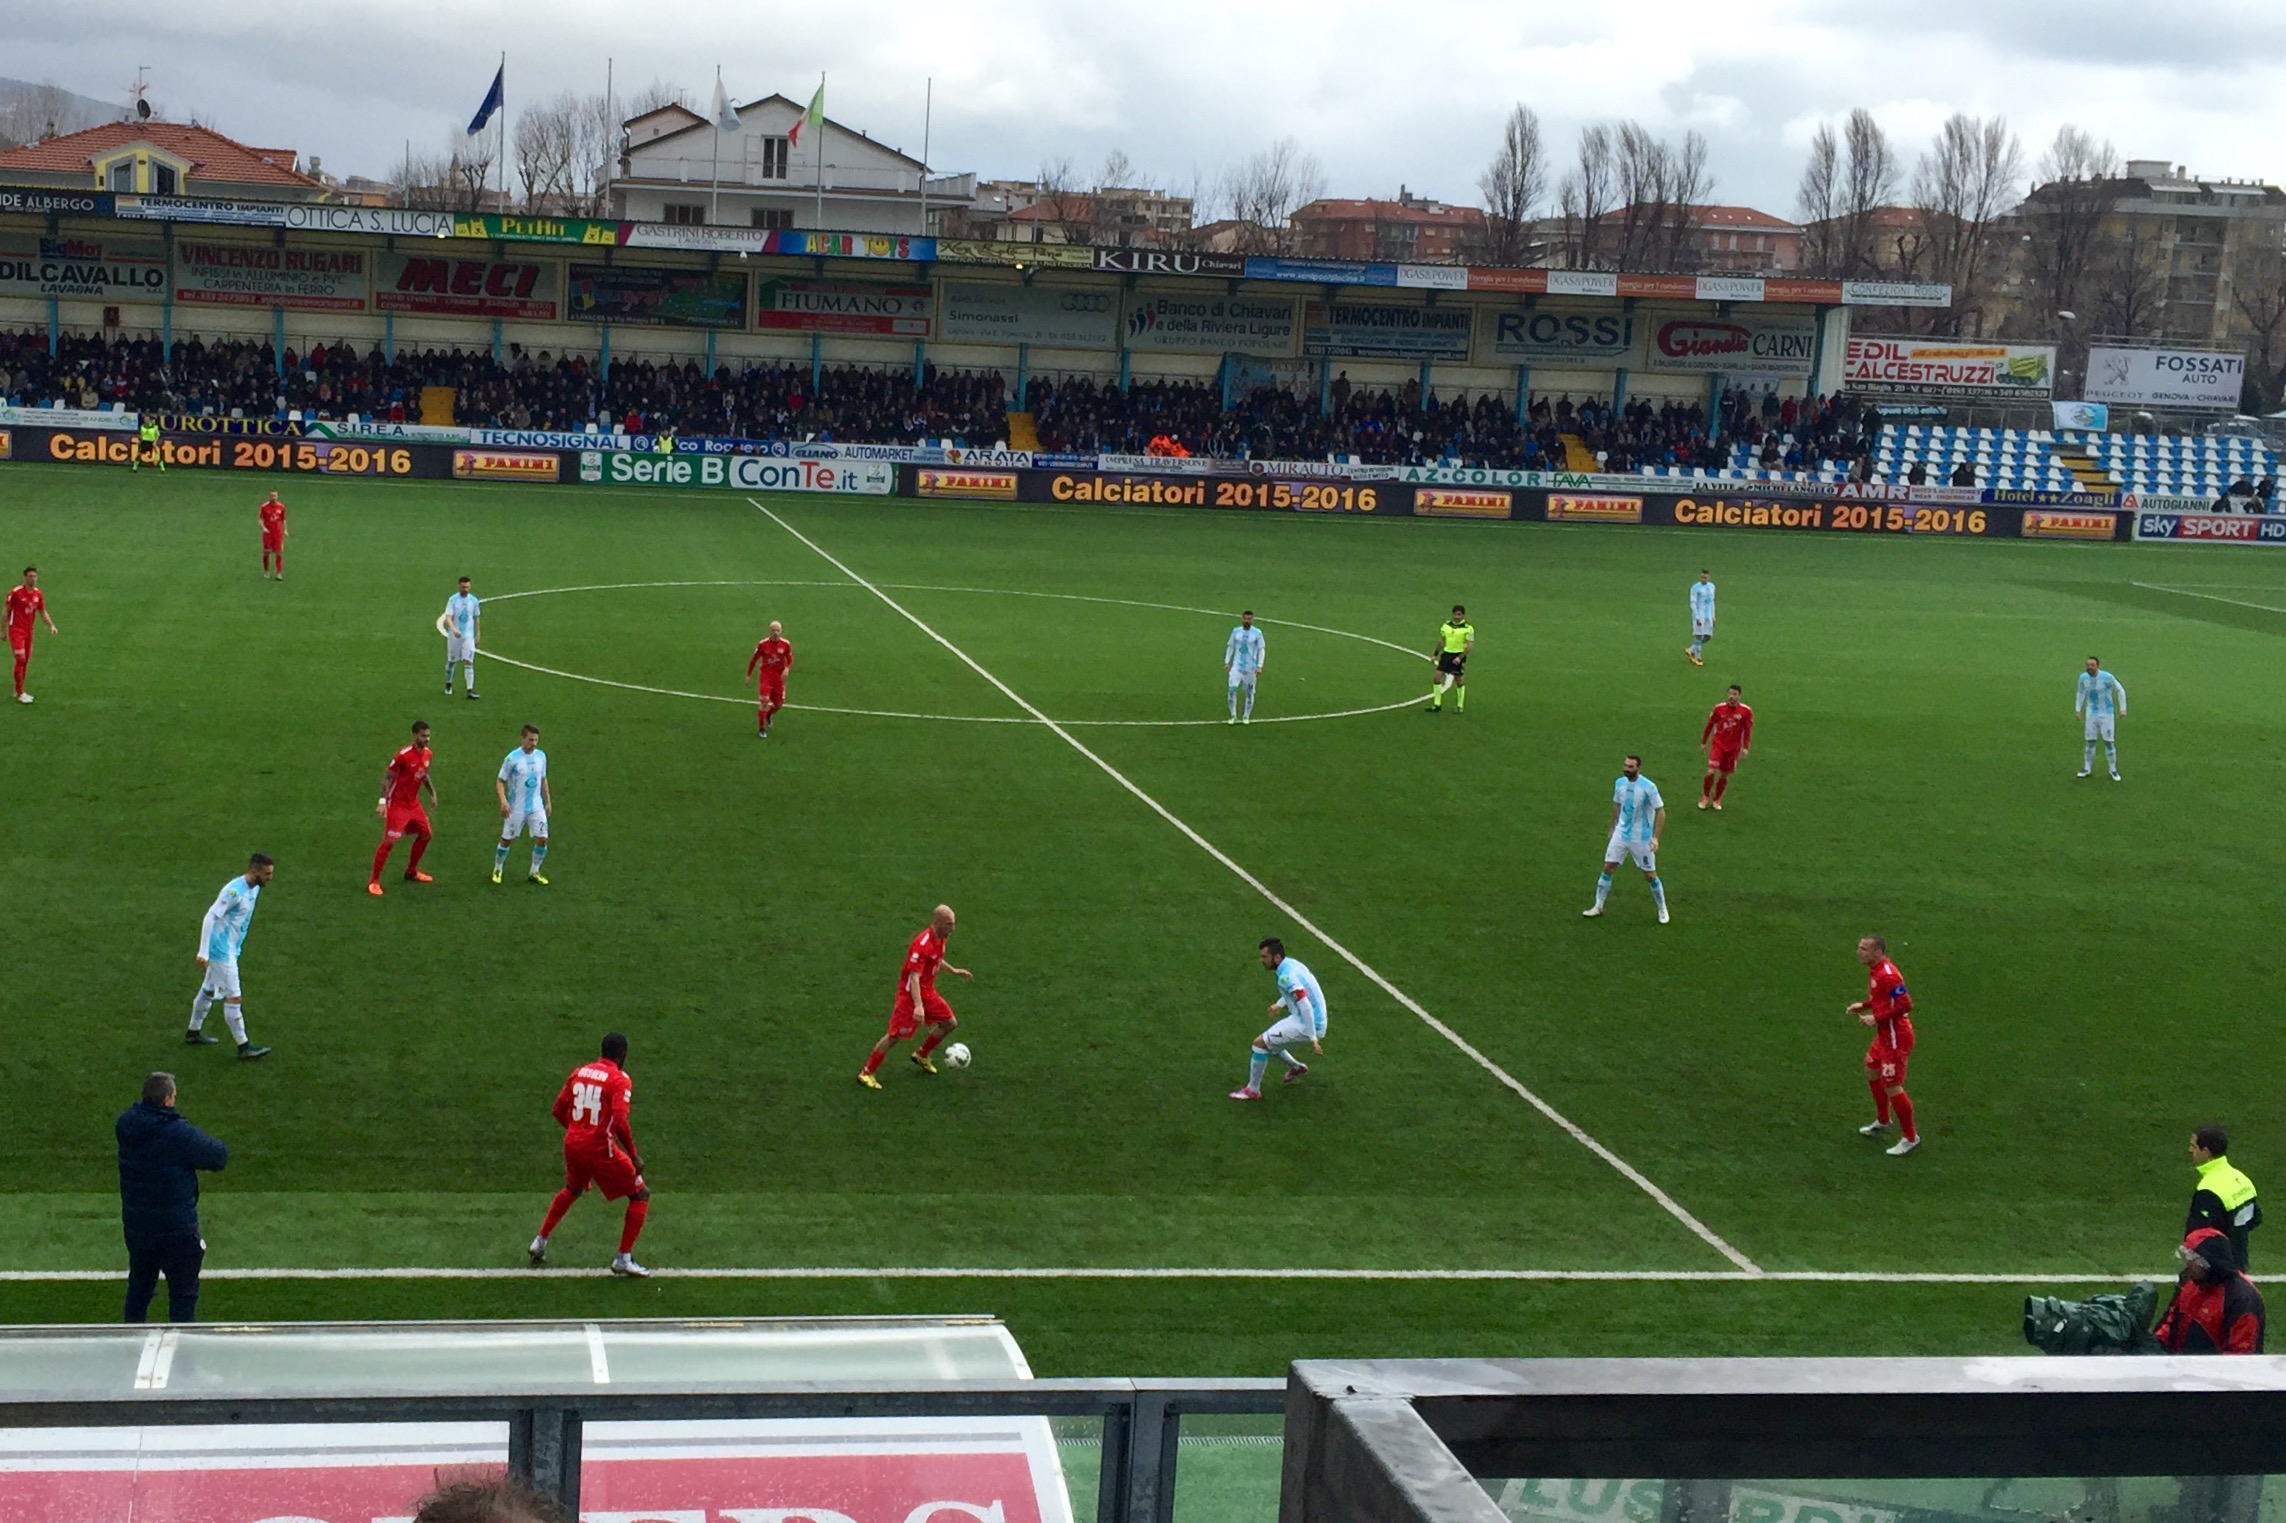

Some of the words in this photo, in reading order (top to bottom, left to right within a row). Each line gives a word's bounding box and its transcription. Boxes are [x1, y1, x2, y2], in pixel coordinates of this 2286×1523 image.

[0, 194, 21, 206] DE
[26, 196, 94, 211] ALBERGO
[139, 198, 234, 211] TERMOCENTRO
[237, 204, 284, 214] IMPIANTI
[288, 206, 363, 230] OTTICA
[370, 211, 385, 231] S.
[391, 212, 451, 235] LUCIA
[636, 225, 700, 239] GASTRINI
[701, 228, 763, 241] ROBERTO
[805, 233, 853, 256] ACAR
[178, 241, 281, 270] VINCENZO
[284, 250, 363, 274] RUGARI
[1202, 259, 1242, 271] Chiavari
[191, 267, 230, 279] INFISSI
[245, 271, 309, 282] ALLUMINIO
[323, 274, 348, 285] PVC
[396, 258, 541, 299] MECI
[40, 283, 104, 296] LAVAGNA
[203, 279, 282, 294] CARPENTERIA
[285, 285, 295, 294] in
[297, 284, 336, 296] FERRO
[781, 292, 902, 314] FIUMANO
[1157, 299, 1206, 317] Banco
[1211, 301, 1224, 317] di
[1229, 302, 1292, 321] Chiavari
[948, 310, 1019, 324] Simonassi
[1328, 305, 1420, 328] TERMOCENTRO
[1422, 310, 1471, 329] IMPIANTI
[1156, 321, 1164, 331] e
[1167, 319, 1198, 333] della
[1201, 321, 1246, 335] Riviera
[1250, 324, 1291, 339] Ligure
[1497, 313, 1633, 346] ROSSI
[1154, 336, 1197, 346] GRUPPO
[1201, 338, 1236, 347] BANCO
[1238, 339, 1288, 349] POPOLARE
[1752, 333, 1814, 358] CARNI
[1848, 341, 1908, 361] EDIL
[2155, 356, 2242, 374] FOSSATI
[2182, 374, 2217, 385] AUTO
[2086, 390, 2144, 400] PEUGEOT
[2151, 392, 2190, 401] GENOVA
[152, 415, 302, 436] UROTTICA
[480, 431, 624, 450] TECNOSIGNAL
[234, 441, 412, 475] 2015-2016
[484, 456, 554, 470] PANINI
[844, 446, 914, 462] AUTOMARKET
[963, 450, 1030, 463] ARATA
[611, 453, 692, 484] Serie
[702, 457, 724, 484] B
[738, 459, 858, 491] ConTe.it
[945, 475, 1012, 488] PANINI
[1553, 471, 1592, 489] FAVA
[1052, 475, 1204, 505] Calciatori
[1215, 482, 1377, 512] 2015-2016
[1442, 494, 1506, 508] PANINI
[1840, 484, 1911, 500] AMR
[1993, 489, 2035, 502] Hotel
[2060, 492, 2115, 507] Zoagli
[1574, 499, 1638, 512] PANINI
[2141, 498, 2211, 512] AUTOGIANNI
[1675, 499, 1822, 528] Calciatori
[1831, 505, 1987, 534] 2015-2016
[2050, 516, 2111, 529] PANINI
[2144, 515, 2177, 537] sky
[2183, 519, 2255, 537] SPORT
[2260, 523, 2286, 538] HD
[572, 1082, 603, 1126] 34
